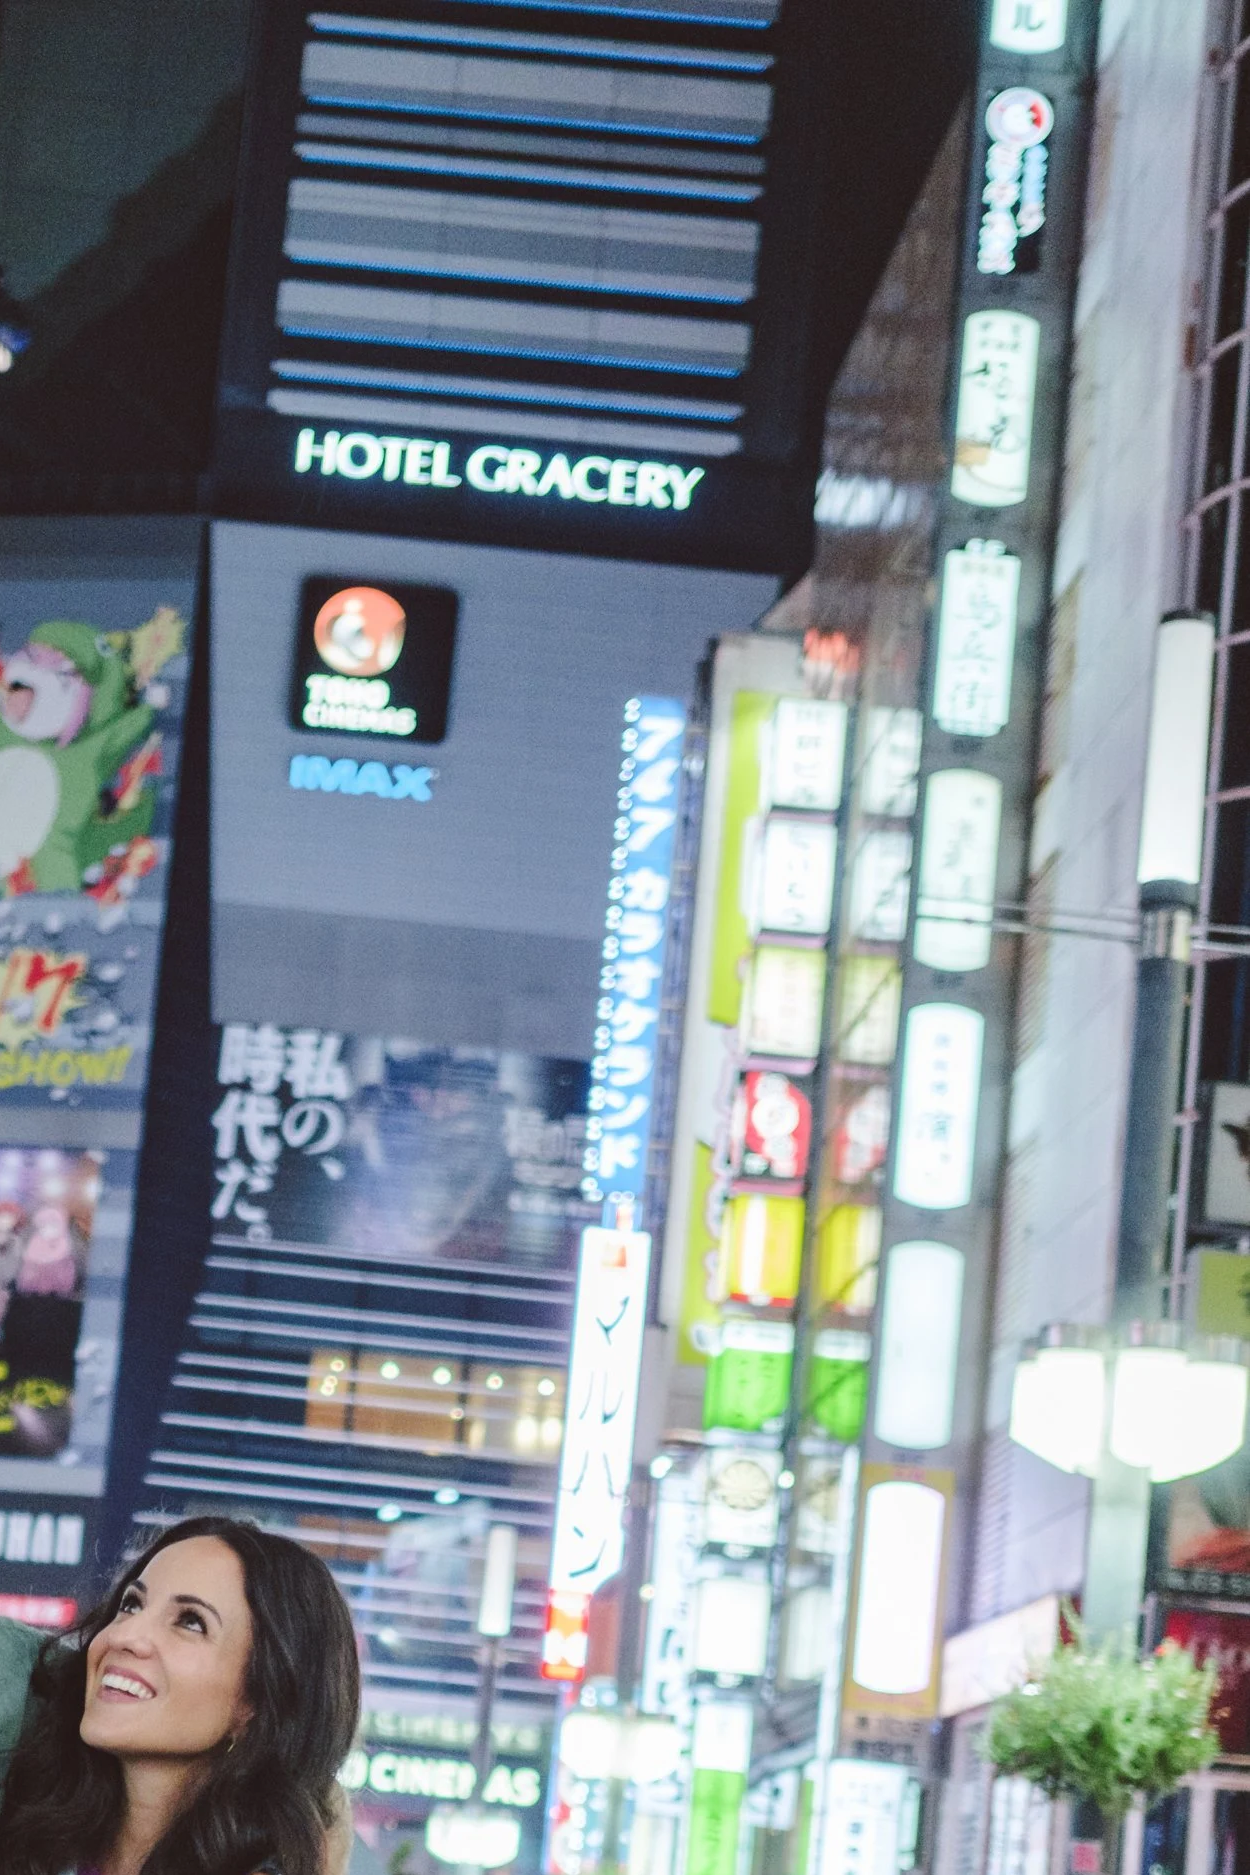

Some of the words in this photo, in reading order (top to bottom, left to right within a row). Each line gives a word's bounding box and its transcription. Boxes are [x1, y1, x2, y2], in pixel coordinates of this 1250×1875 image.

[295, 428, 462, 488] HOTEL
[466, 444, 704, 510] GRACERY
[303, 700, 417, 735] CINEMAS
[289, 755, 433, 802] IMAX
[210, 1023, 286, 1242] 時代だ。
[282, 1028, 350, 1180] 私の、
